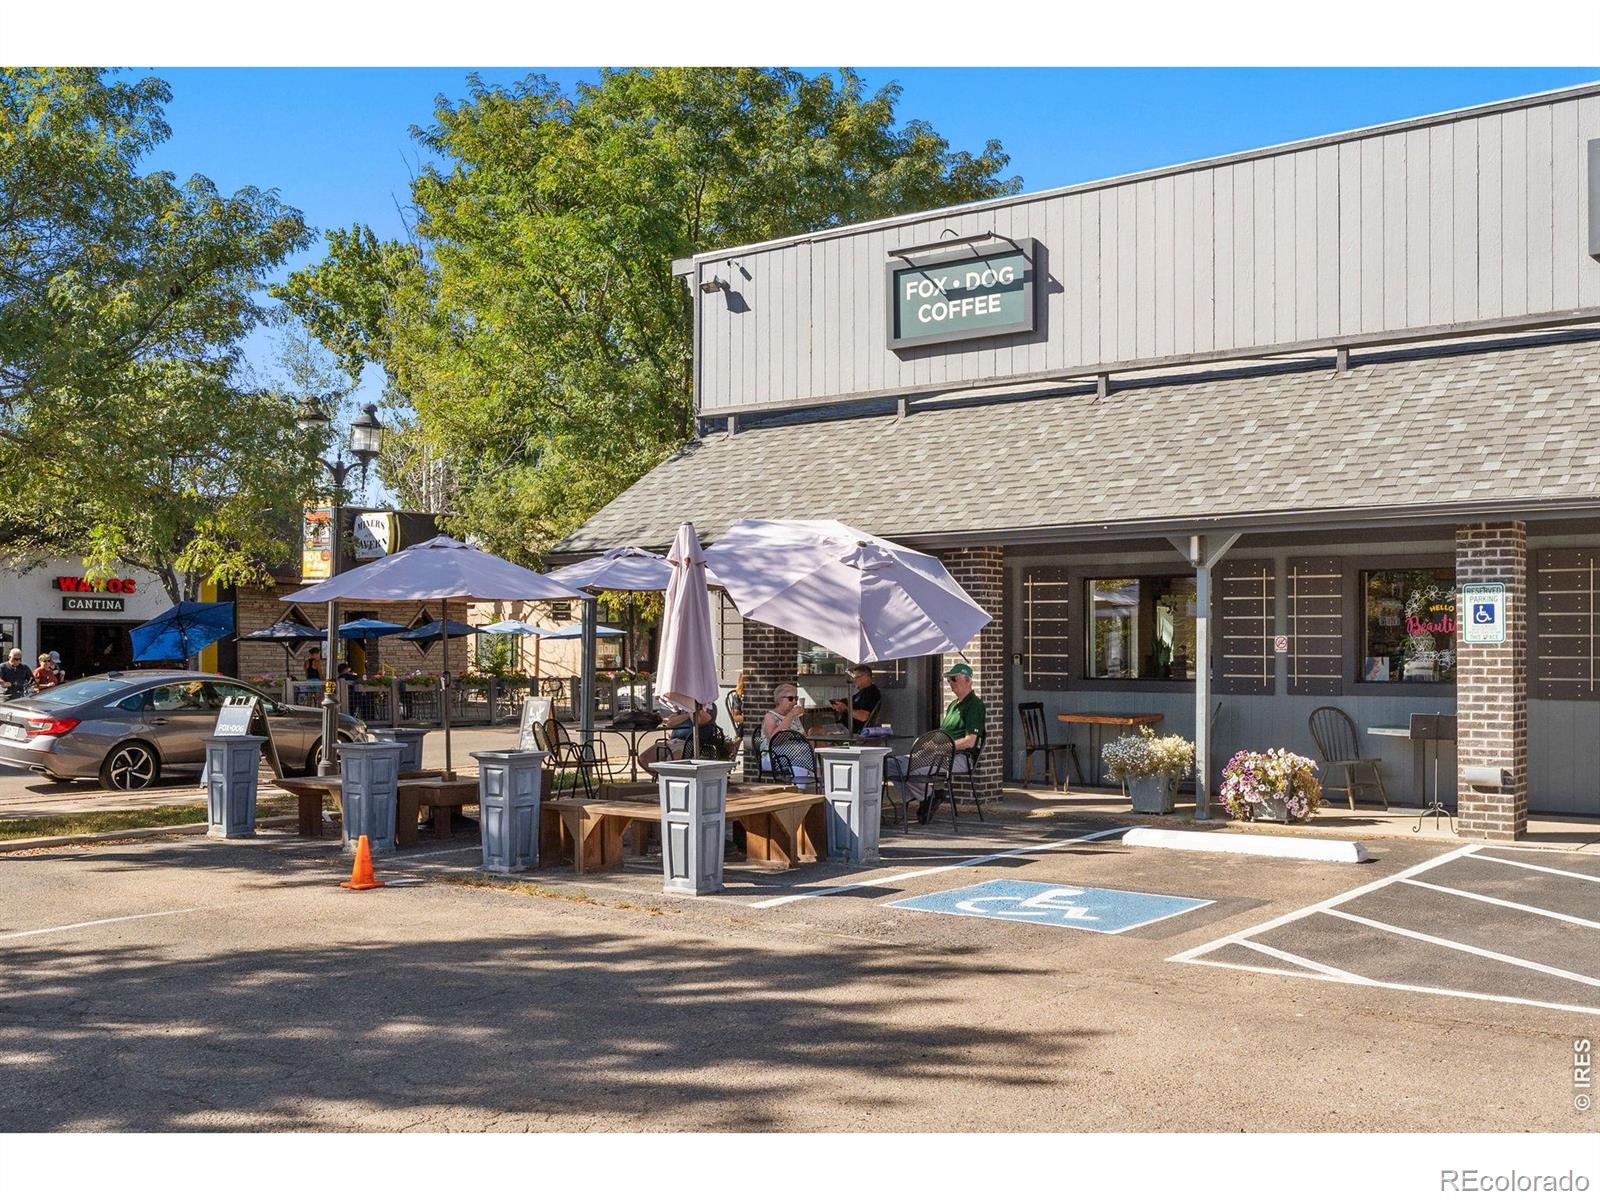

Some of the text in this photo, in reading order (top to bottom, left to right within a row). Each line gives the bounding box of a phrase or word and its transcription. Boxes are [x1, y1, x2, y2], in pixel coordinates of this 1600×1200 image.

[906, 266, 1014, 300] FOX DOG
[918, 293, 1001, 323] COFFEE
[355, 538, 387, 550] AVERN
[1466, 586, 1502, 594] RESERVED
[68, 599, 122, 610] CANTINA
[1469, 595, 1499, 603] PARKING
[1429, 604, 1455, 612] HELLO
[1406, 614, 1457, 637] Beauti
